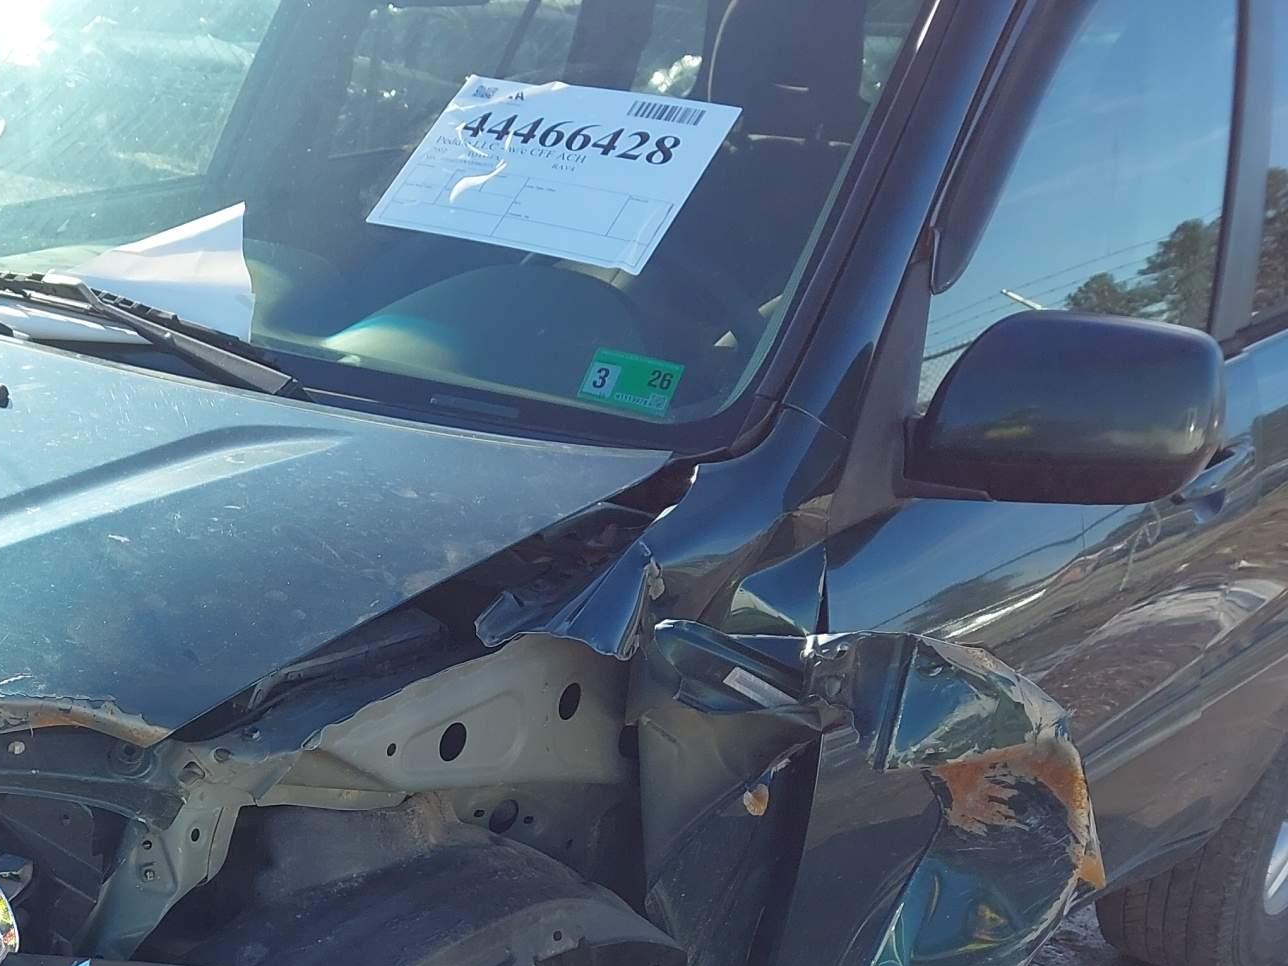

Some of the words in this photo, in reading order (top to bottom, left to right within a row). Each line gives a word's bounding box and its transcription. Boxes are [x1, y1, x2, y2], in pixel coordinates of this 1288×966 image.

[462, 111, 681, 165] 44466428
[592, 367, 610, 389] 3
[648, 369, 674, 390] 26
